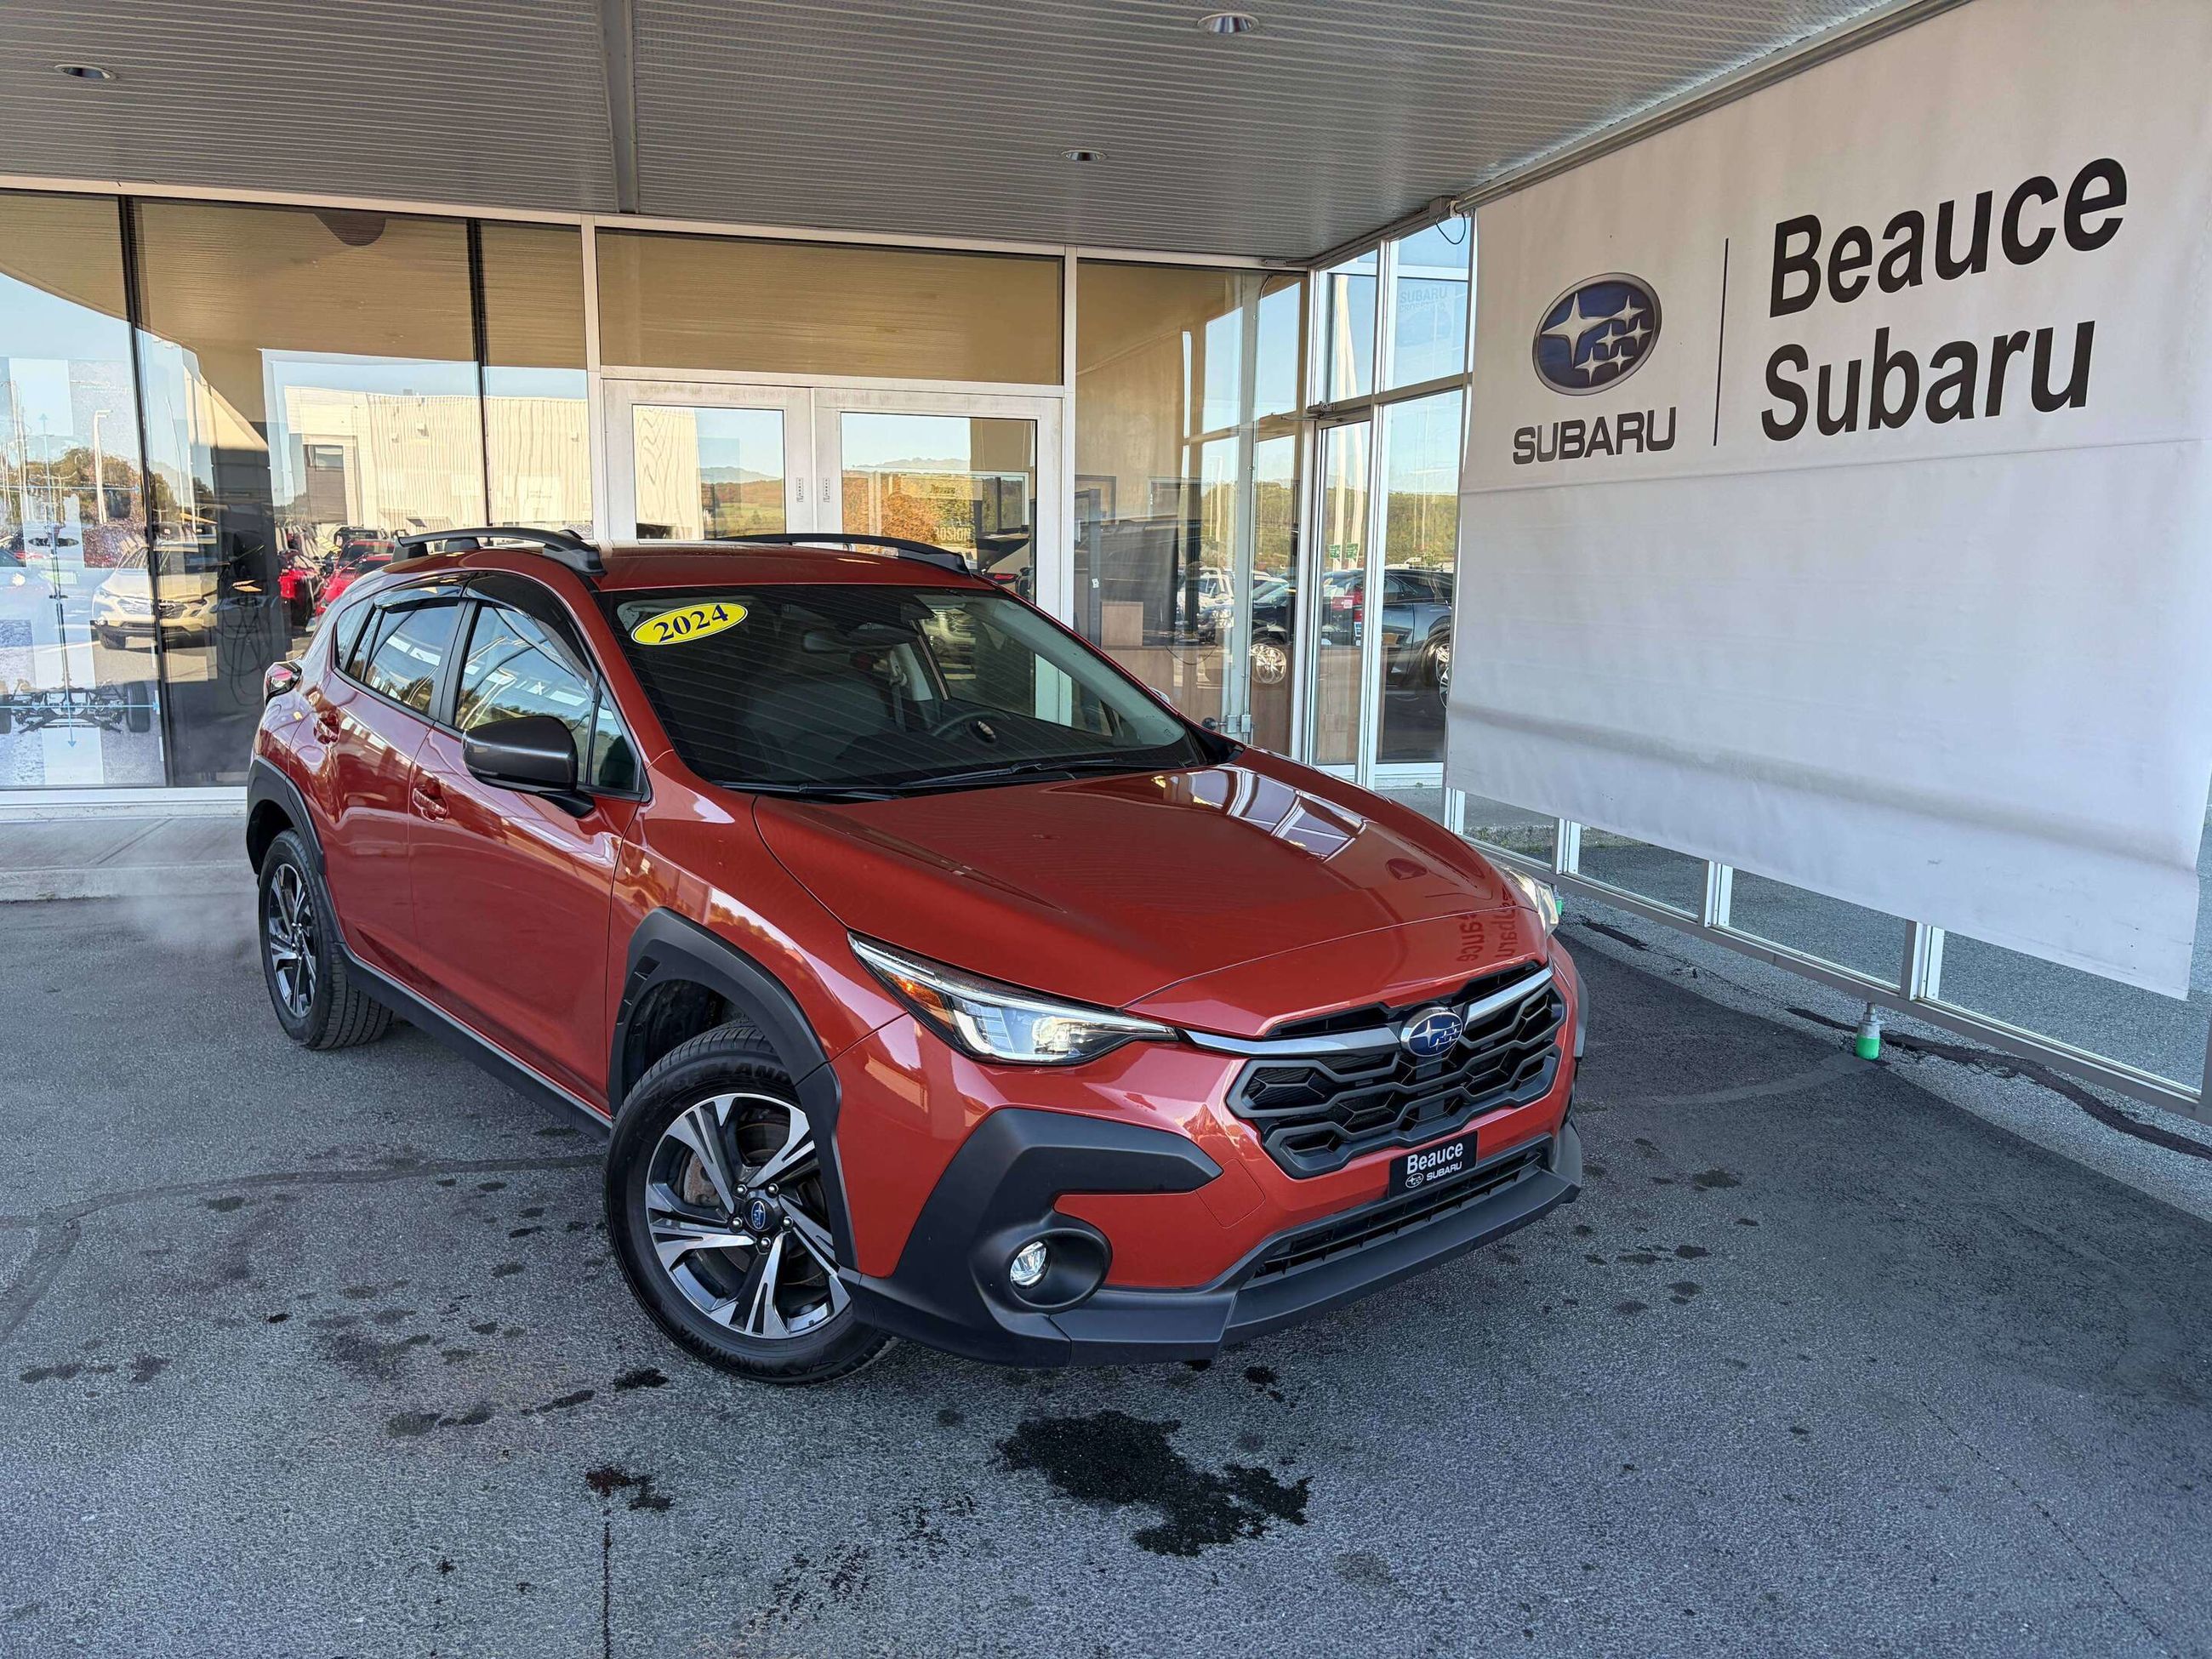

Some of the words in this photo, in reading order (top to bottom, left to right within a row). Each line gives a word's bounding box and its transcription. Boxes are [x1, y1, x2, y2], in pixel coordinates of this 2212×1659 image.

[1770, 157, 2127, 318] Beauce
[1761, 320, 2095, 442] Subaru
[1513, 407, 1677, 465] SUBARU
[653, 604, 728, 643] 2024
[1406, 1143, 1463, 1175] Beauce
[1426, 1161, 1462, 1182] SUBARU
